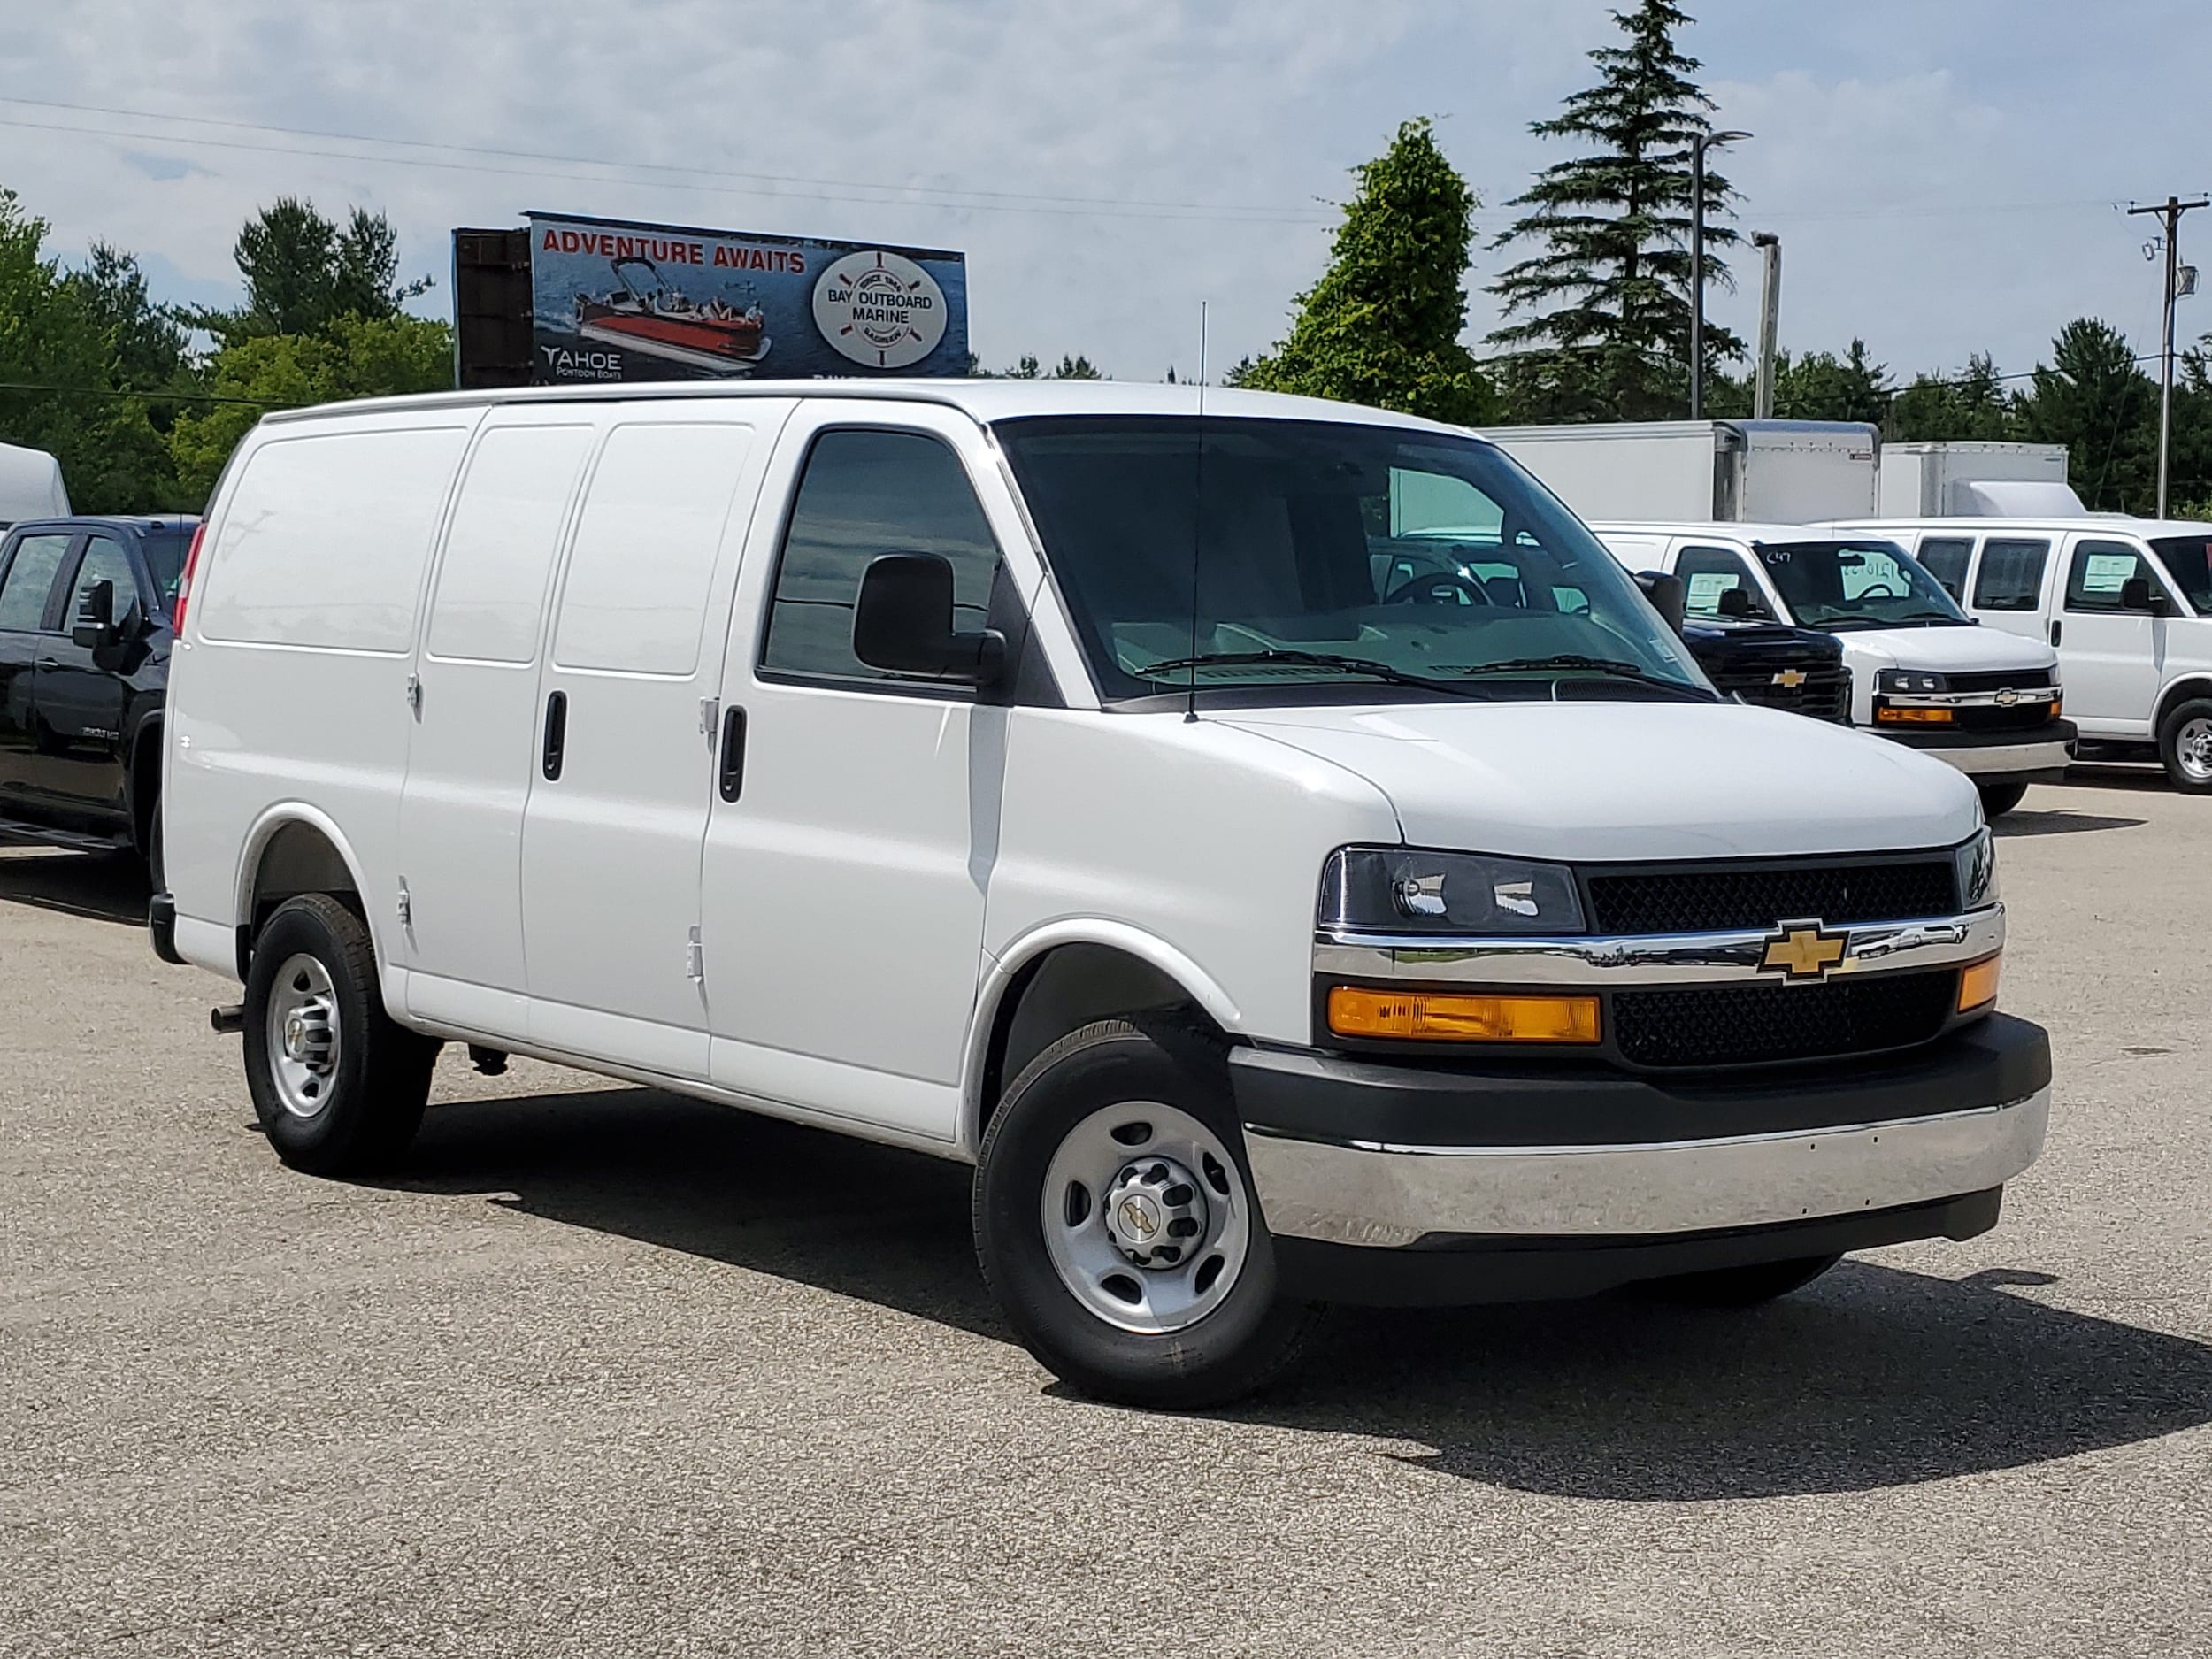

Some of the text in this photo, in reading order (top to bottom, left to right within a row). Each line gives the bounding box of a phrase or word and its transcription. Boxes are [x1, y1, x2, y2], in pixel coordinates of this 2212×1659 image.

[542, 228, 805, 273] ADVENTURE AWAITS
[827, 289, 933, 310] BAY OUTBOARD
[852, 307, 910, 324] MARINE
[541, 345, 622, 370] TAHOE
